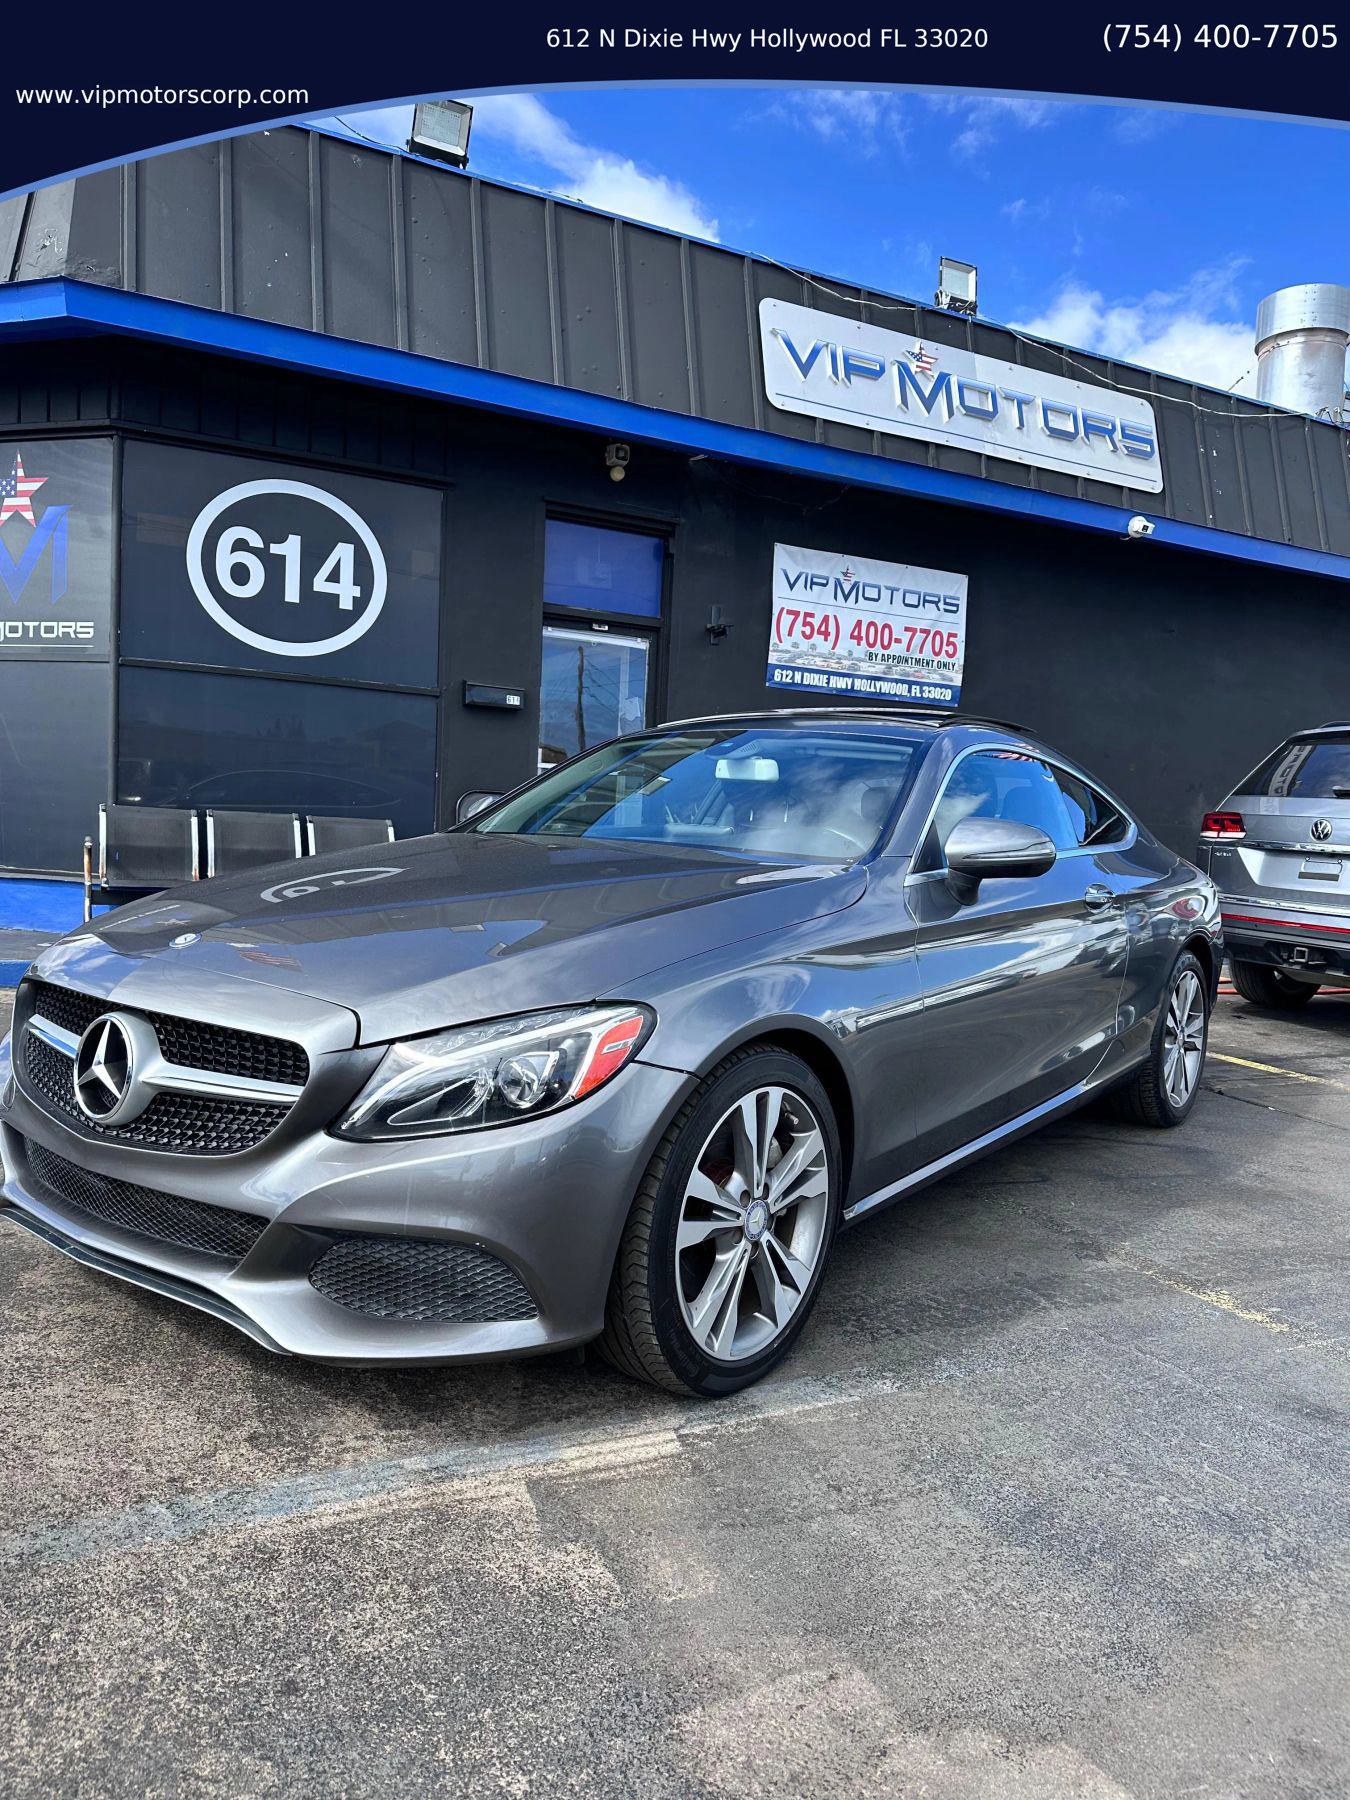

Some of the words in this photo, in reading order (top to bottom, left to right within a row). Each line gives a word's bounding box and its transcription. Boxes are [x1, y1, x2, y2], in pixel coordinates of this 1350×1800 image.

[770, 328, 886, 388] VIP
[891, 359, 1155, 460] MOTORS
[214, 526, 361, 610] 614
[781, 568, 830, 592] VIP
[833, 577, 960, 614] MOTORS
[775, 607, 840, 650] (754)
[849, 619, 958, 659] 400-7705
[774, 669, 793, 682] 612
[795, 671, 802, 683] N
[803, 673, 829, 687] DIXIE
[830, 676, 853, 689] HWY
[855, 678, 910, 697] HOLLYWOOD,
[911, 685, 922, 697] FL
[923, 687, 952, 701] 33020
[868, 651, 879, 662] BY
[881, 654, 935, 669] APPOINTMENT
[937, 660, 956, 671] ONLY
